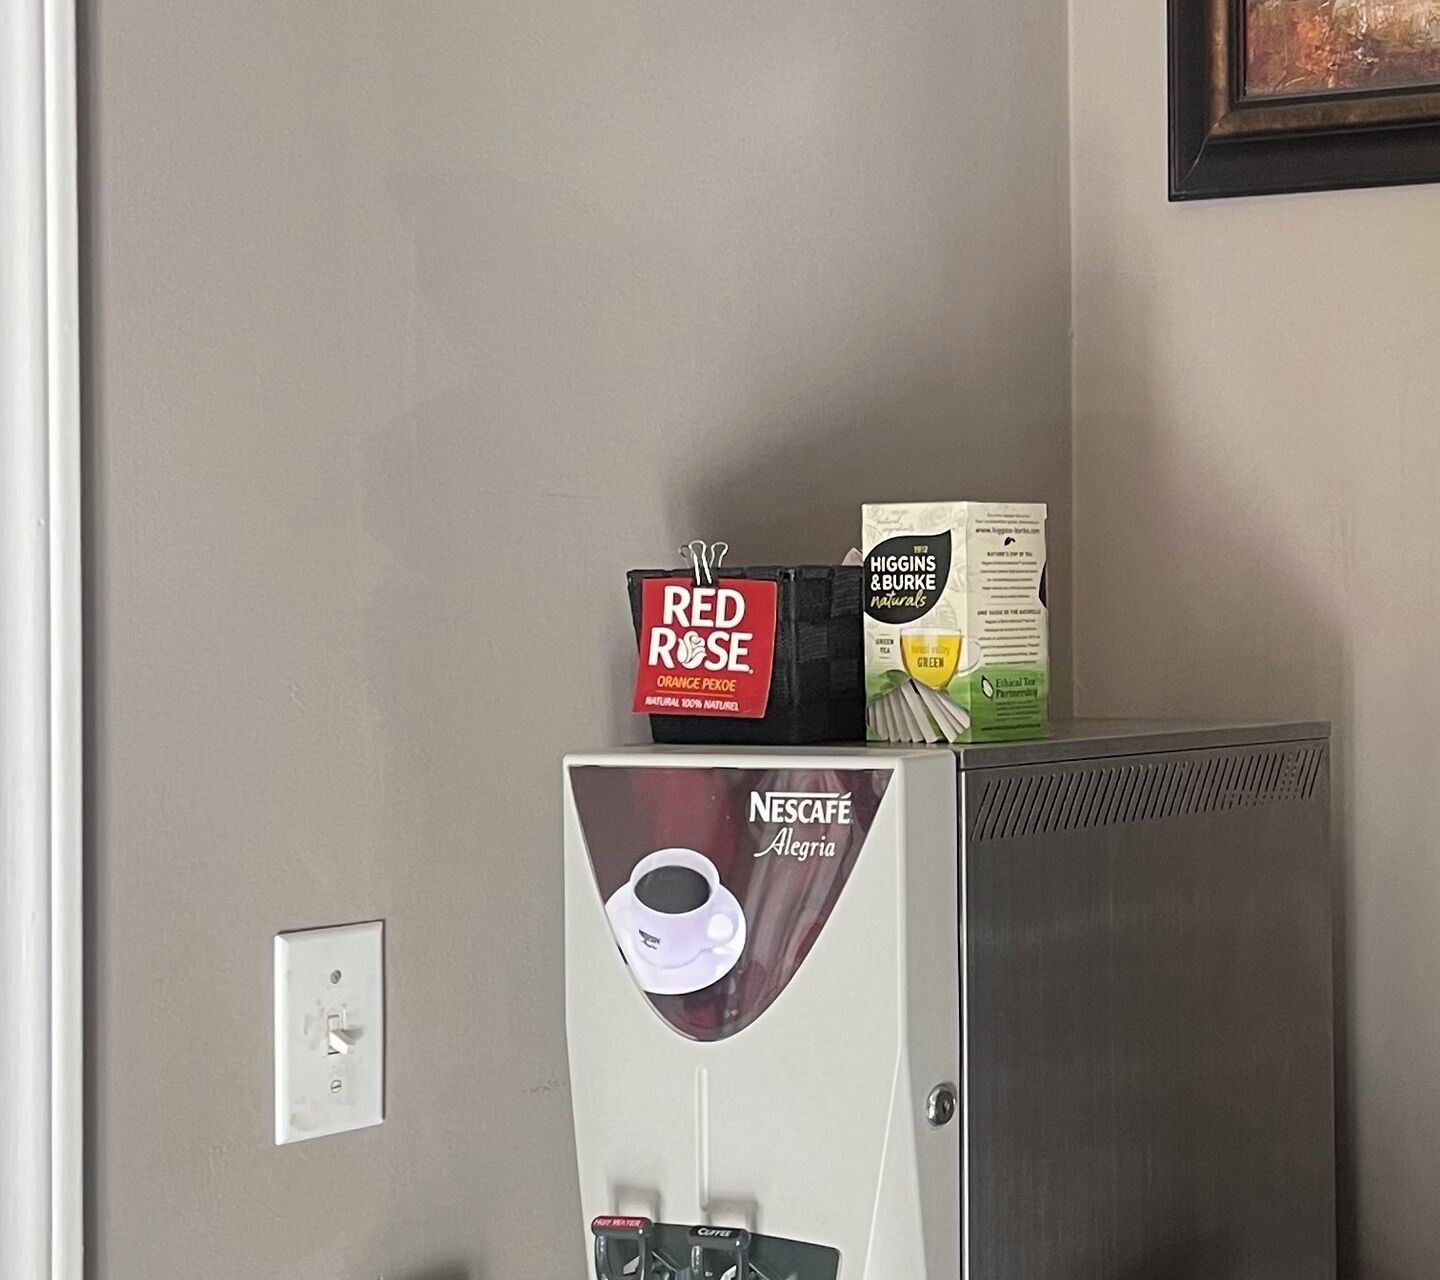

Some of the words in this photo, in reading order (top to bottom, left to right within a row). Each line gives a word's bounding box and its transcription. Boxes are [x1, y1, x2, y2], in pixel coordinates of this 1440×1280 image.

[870, 555, 936, 573] HIGGINS
[882, 574, 936, 591] BURKE
[663, 585, 746, 629] RED
[869, 589, 927, 609] naturals
[647, 626, 753, 672] ROSE
[916, 656, 945, 668] GREEN
[656, 675, 702, 690] ORANGE
[701, 678, 738, 693] PEKOE
[644, 696, 681, 708] NATURAL
[681, 698, 703, 710] 100%
[703, 699, 740, 712] NATUREL
[748, 790, 853, 825] NESCAFÉ
[753, 827, 836, 862] Alegria
[611, 1220, 642, 1228] WATER
